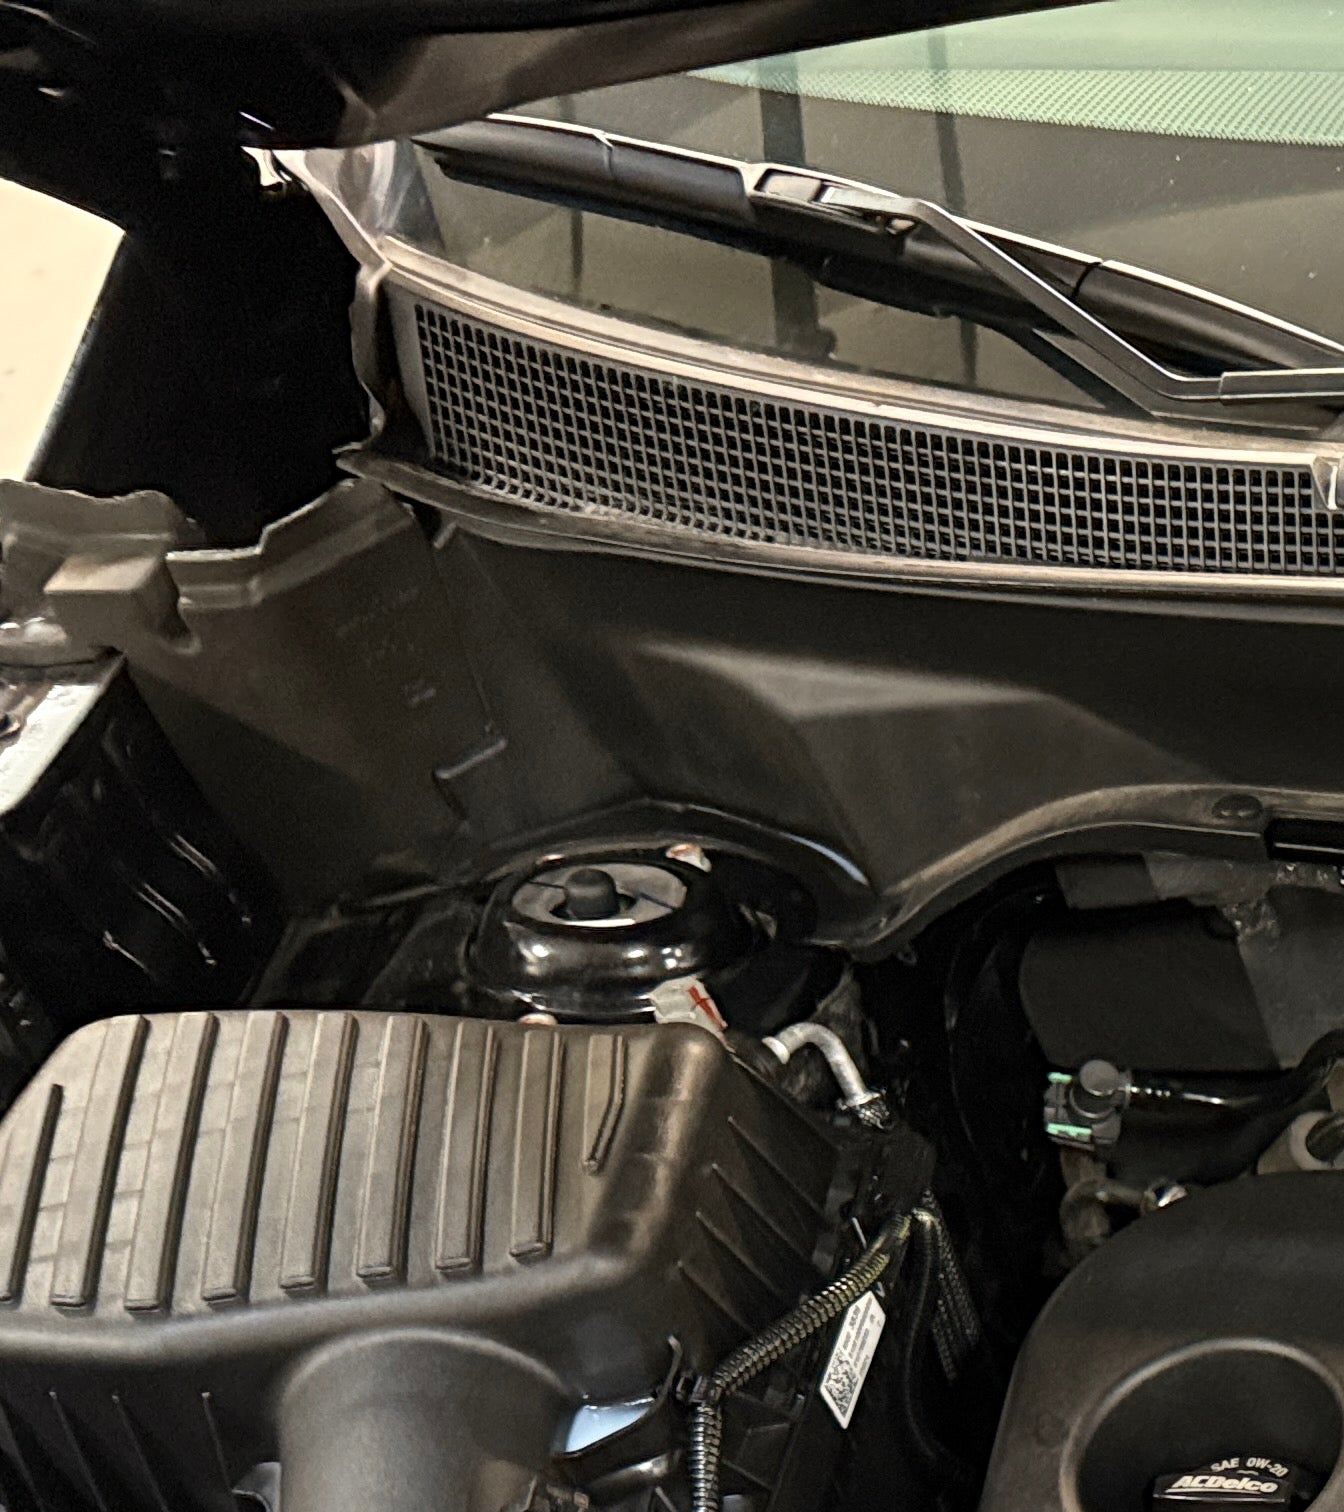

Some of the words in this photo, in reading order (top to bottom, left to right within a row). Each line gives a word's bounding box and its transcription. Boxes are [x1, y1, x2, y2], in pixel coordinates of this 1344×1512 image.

[1210, 1457, 1240, 1473] SAE
[1245, 1456, 1289, 1478] 0W-20
[1171, 1475, 1279, 1493] ACDelco
